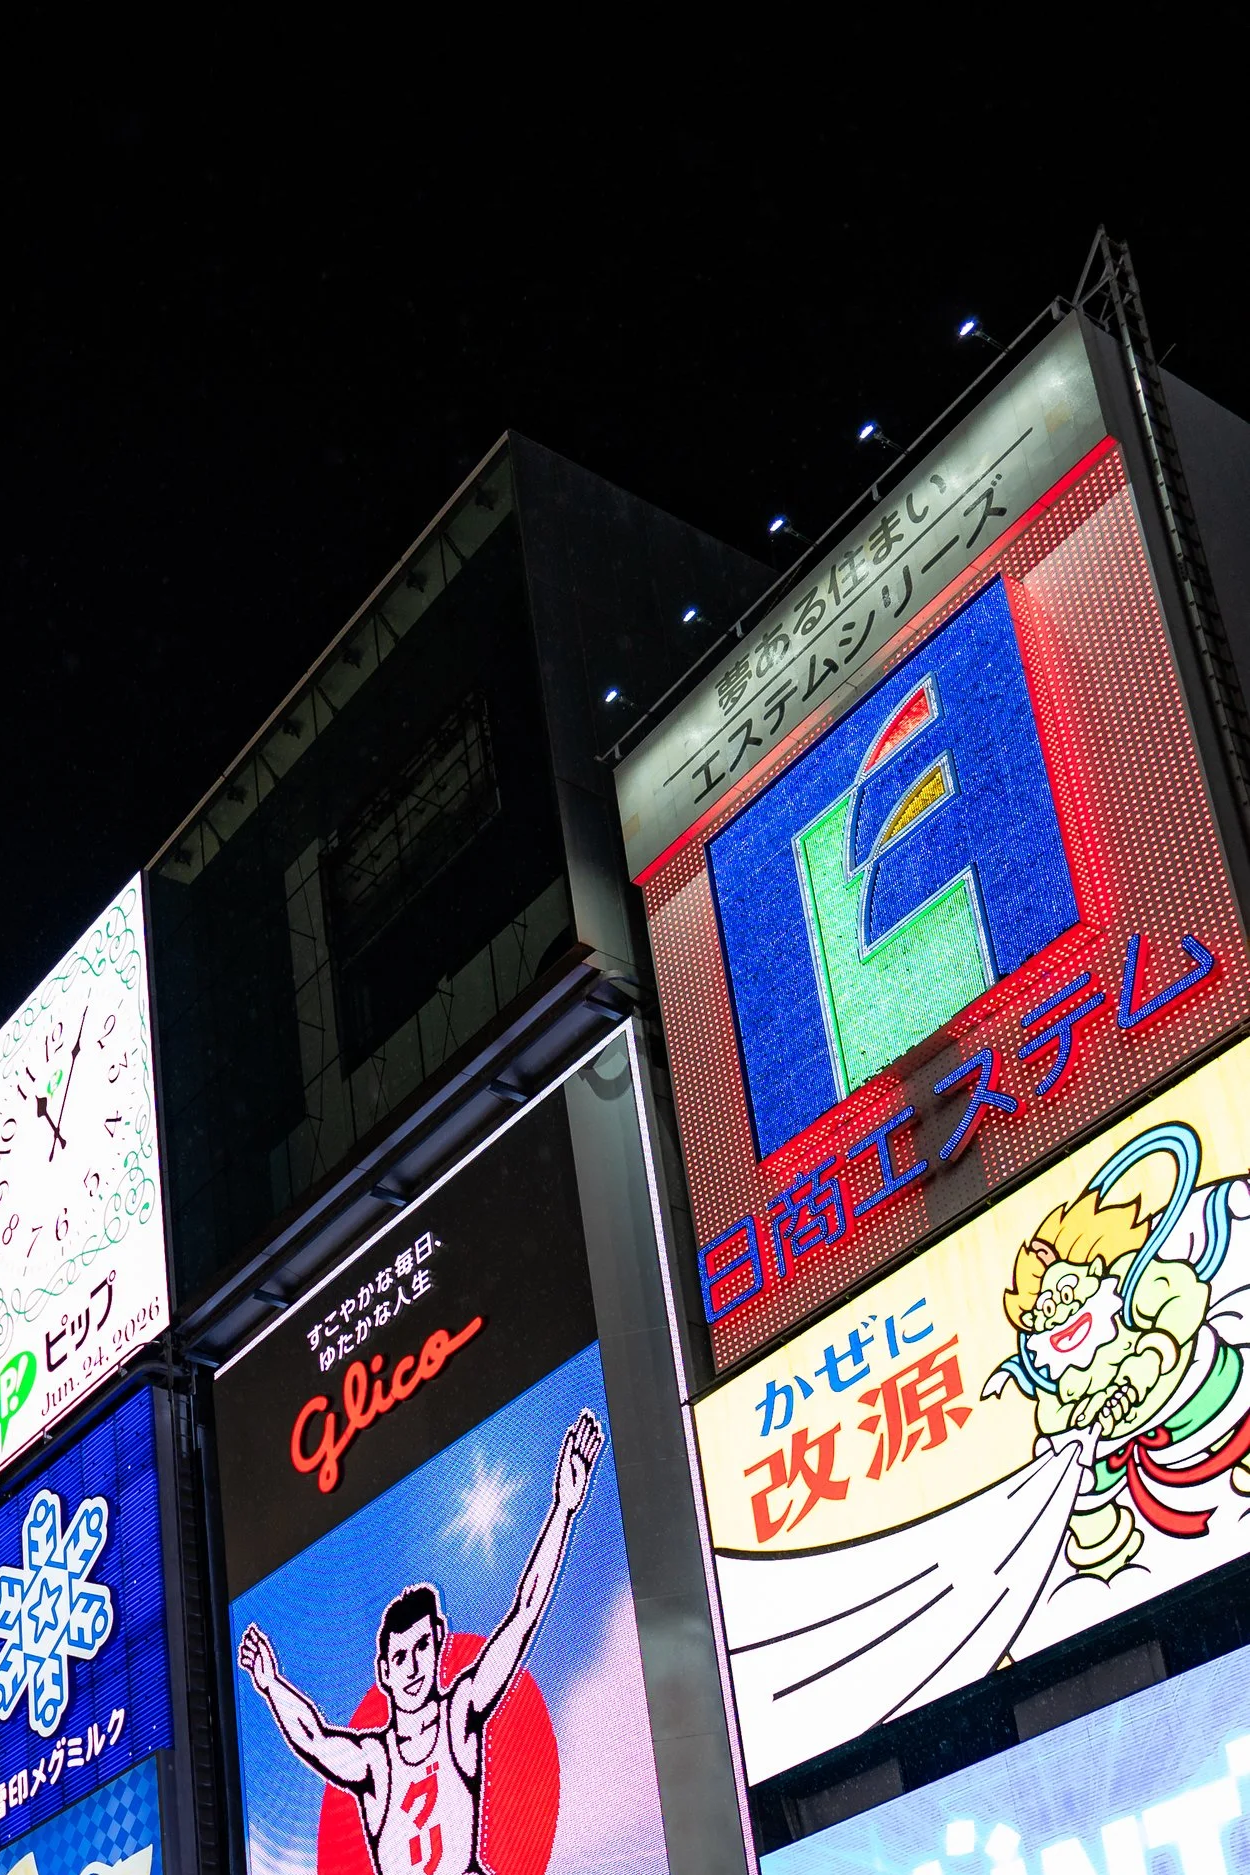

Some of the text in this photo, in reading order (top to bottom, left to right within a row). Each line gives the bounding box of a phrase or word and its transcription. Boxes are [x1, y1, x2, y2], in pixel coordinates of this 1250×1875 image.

[692, 473, 1007, 805] エステムシリーズ
[715, 473, 947, 718] 夢ある住まい
[697, 932, 1215, 1325] 日商エステム
[1, 1213, 20, 1245] 8
[26, 1225, 43, 1258] 7
[306, 1231, 442, 1351] すこやかな毎日、
[40, 1377, 80, 1418] Jun.
[112, 1296, 160, 1353] 2026
[44, 1269, 117, 1373] ピップ
[318, 1268, 433, 1372] ゆたかな人生
[756, 1297, 935, 1439] かぜに
[289, 1315, 484, 1494] Glico
[743, 1334, 975, 1545] 改源
